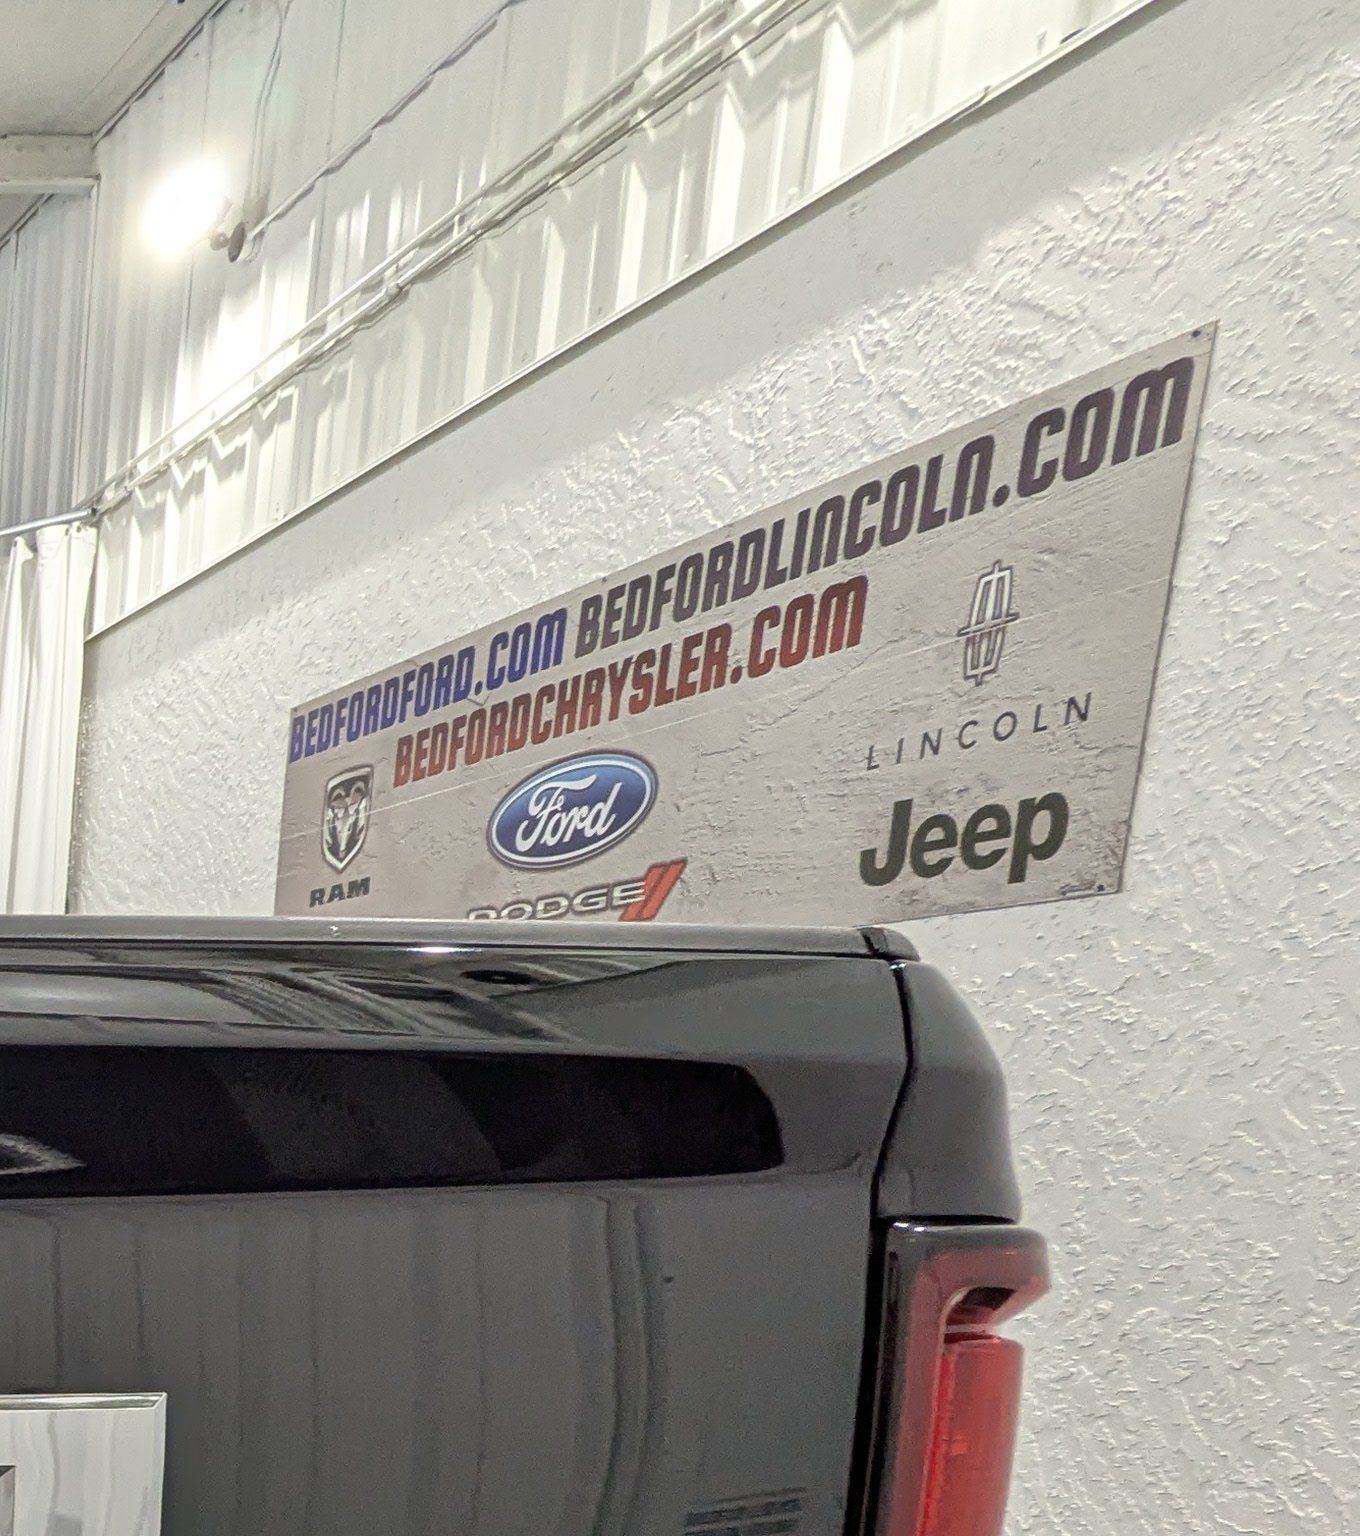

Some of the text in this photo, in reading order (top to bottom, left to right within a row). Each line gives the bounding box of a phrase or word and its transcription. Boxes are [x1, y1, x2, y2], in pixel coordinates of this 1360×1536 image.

[289, 357, 1195, 763] BEDFORDFORD.COM BEDFORDLINCOLN.COM
[393, 575, 869, 788] BEDFORDCHRYSLER.COM
[866, 691, 1093, 771] LINCOLN
[515, 774, 622, 852] Ford
[859, 791, 1069, 887] Jeep
[308, 876, 371, 909] RAM
